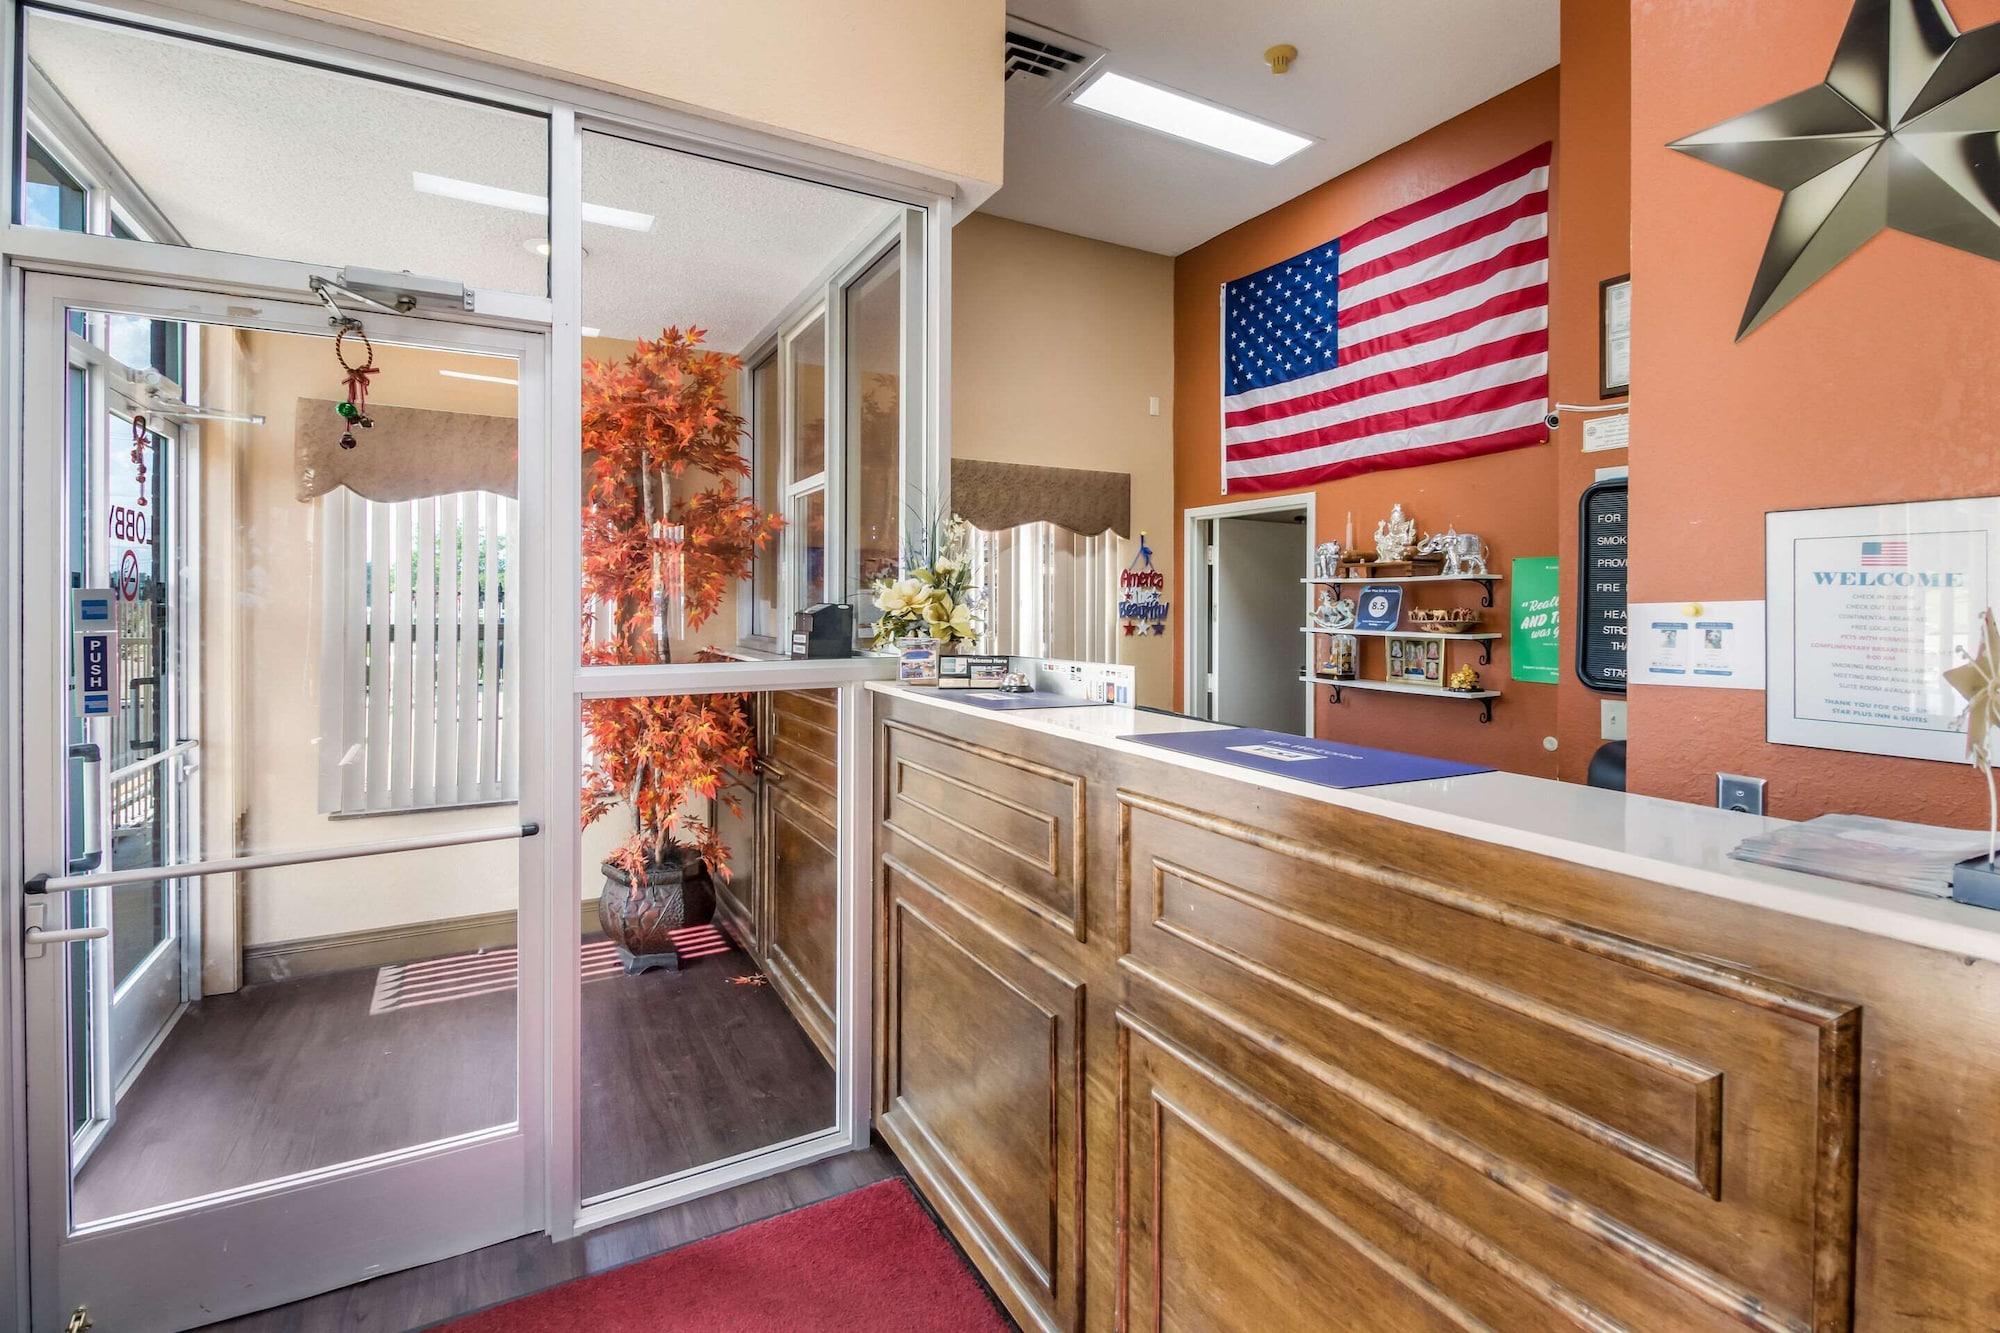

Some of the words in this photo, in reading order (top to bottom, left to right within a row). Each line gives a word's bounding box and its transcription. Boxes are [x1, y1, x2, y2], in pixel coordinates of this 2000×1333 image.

[1597, 513, 1622, 524] FOR
[1120, 568, 1164, 590] America
[1813, 571, 1965, 587] WELCOME
[1596, 583, 1621, 592] FIRE
[1119, 601, 1170, 623] Beautiful
[1371, 602, 1385, 610] 8.5
[1520, 614, 1548, 630] AND
[1531, 628, 1551, 639] was
[90, 640, 102, 687] PUSH
[1824, 698, 1852, 706] THANK
[1853, 709, 1873, 717] PLUS
[1875, 711, 1891, 719] INN
[1900, 715, 1928, 723] SUITES
